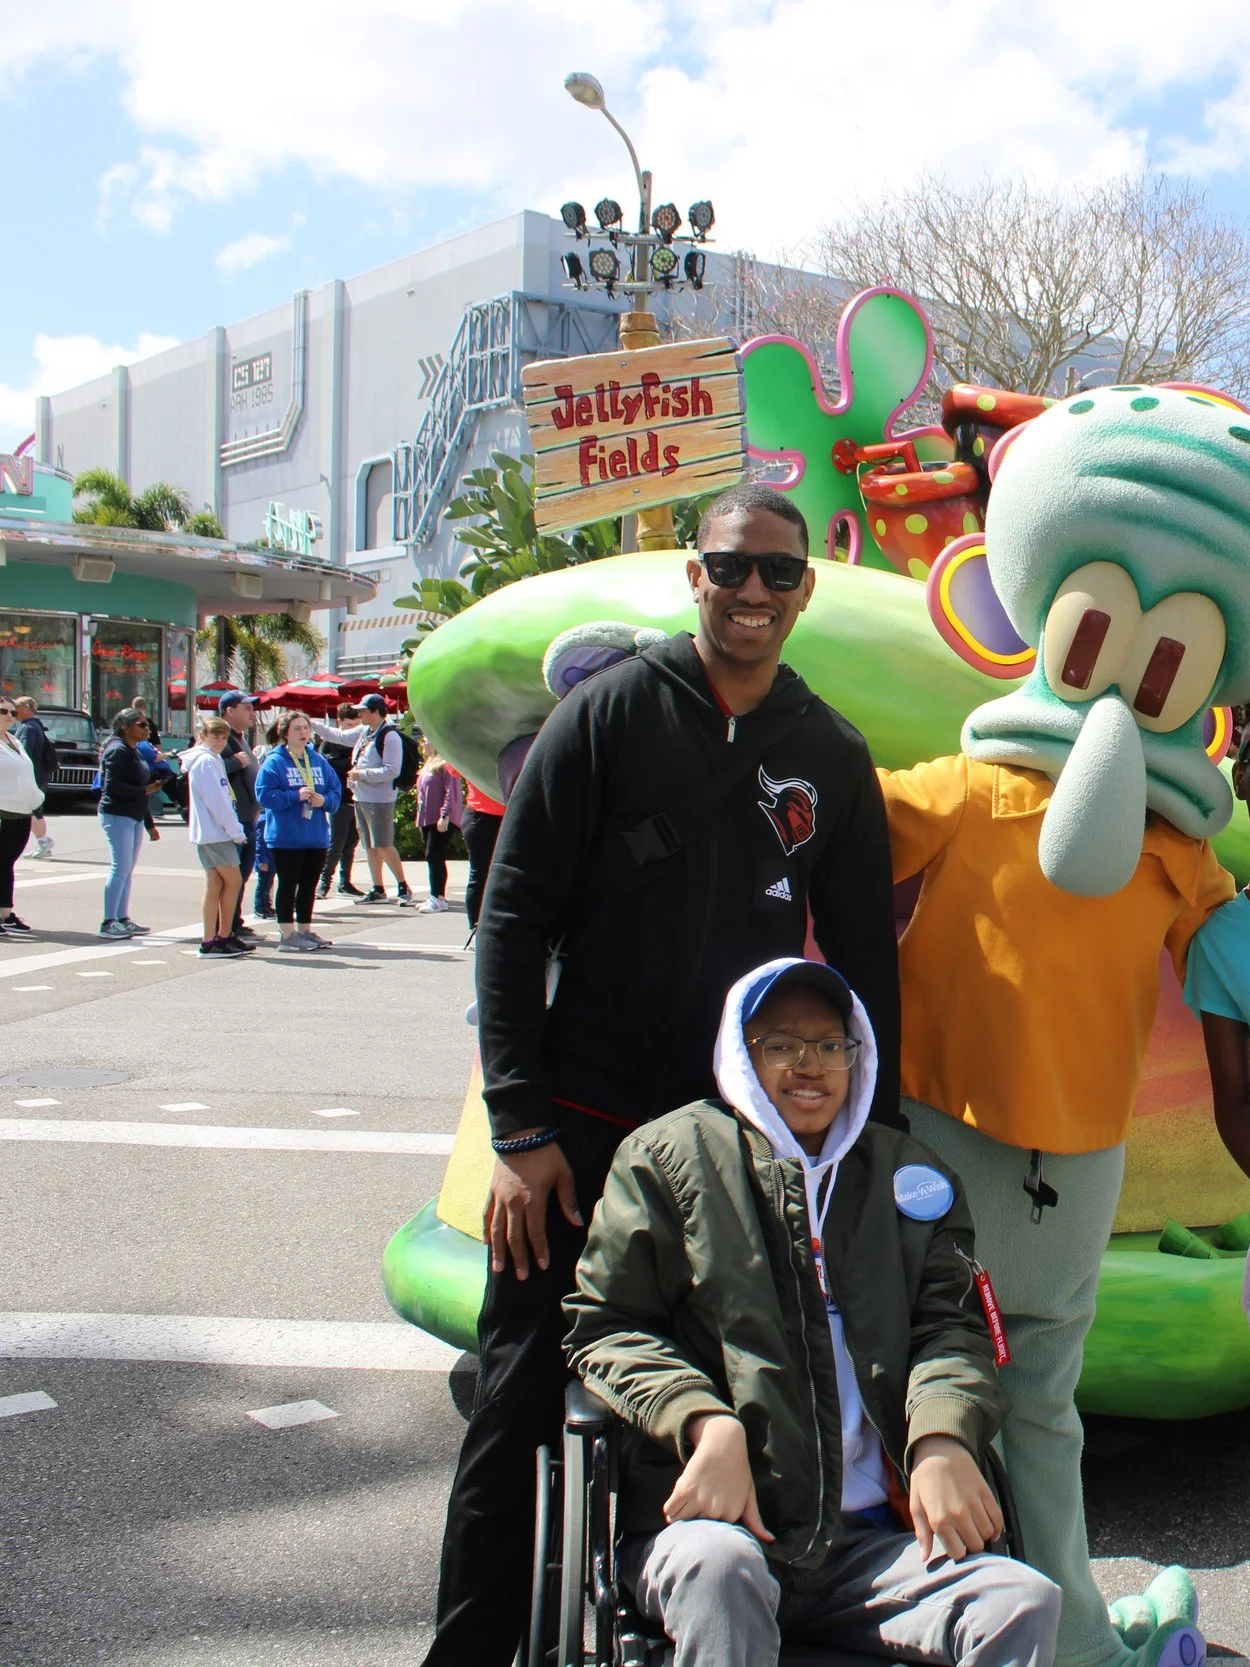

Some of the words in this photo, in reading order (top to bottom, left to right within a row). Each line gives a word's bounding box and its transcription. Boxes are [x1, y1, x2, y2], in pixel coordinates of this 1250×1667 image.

[251, 382, 273, 408] 1985
[578, 431, 680, 486] Fields
[765, 888, 792, 901] adidas
[982, 1283, 995, 1312] REMOVE
[990, 1311, 1002, 1337] BEFORE
